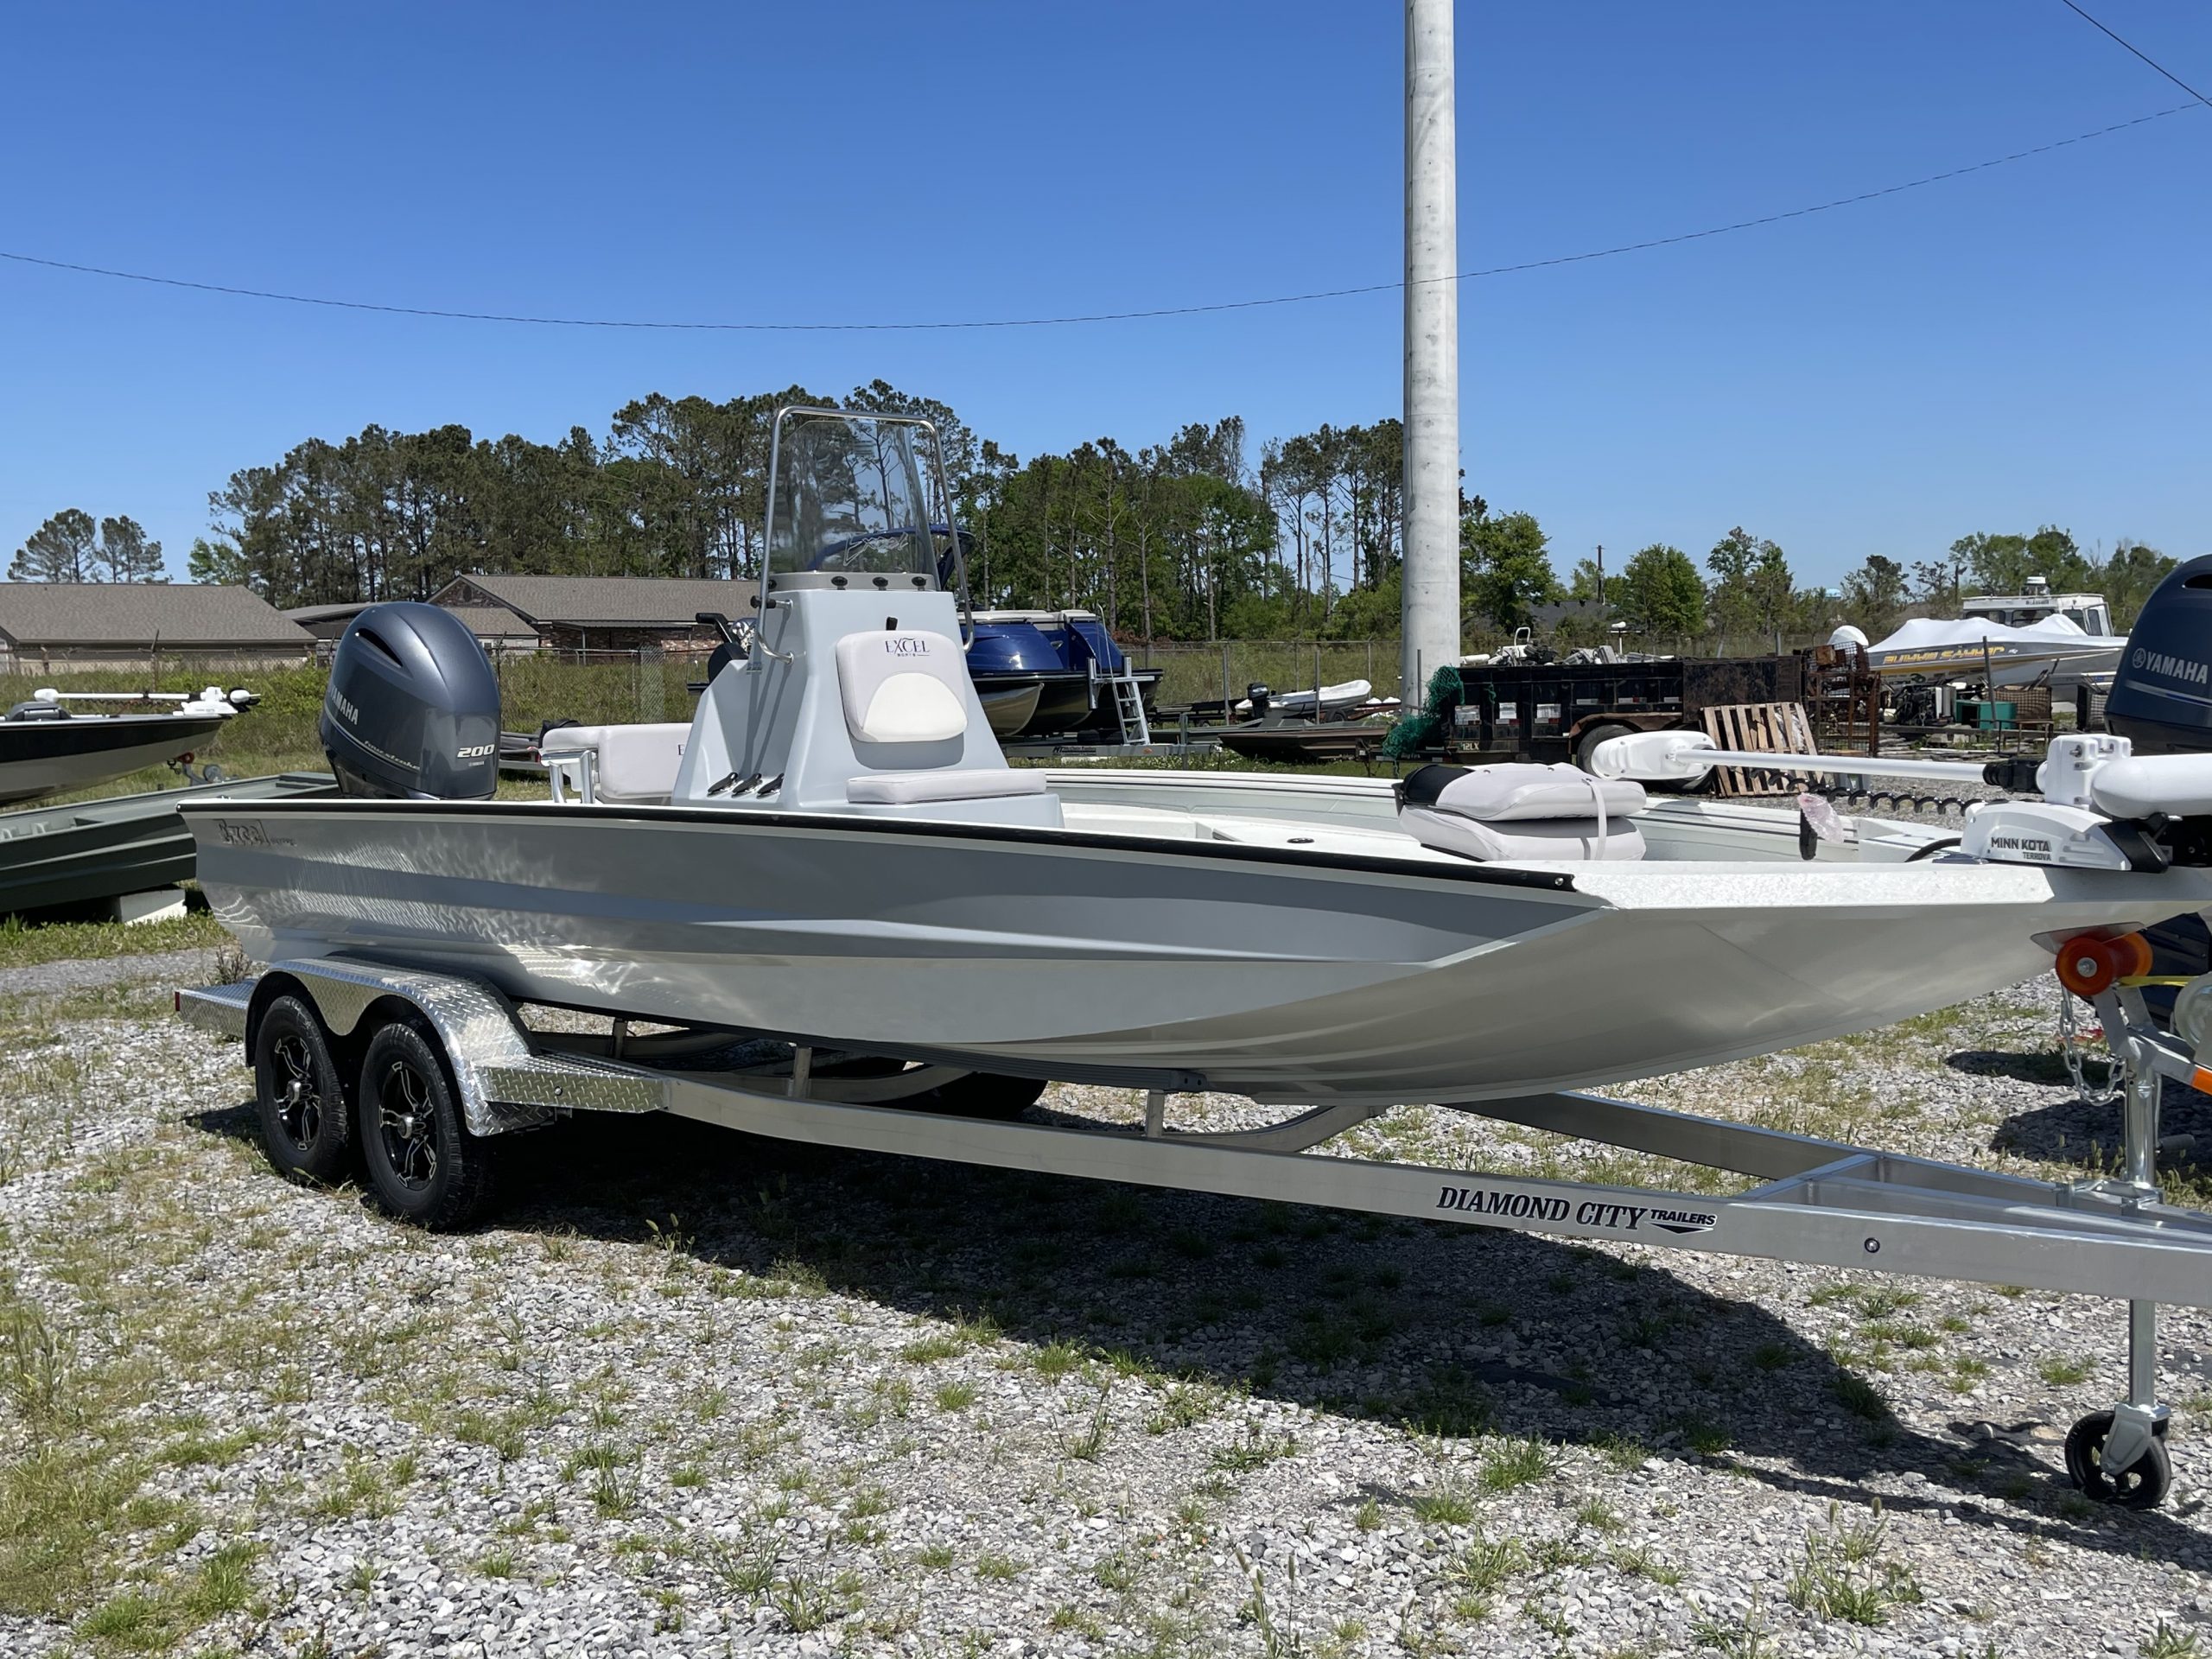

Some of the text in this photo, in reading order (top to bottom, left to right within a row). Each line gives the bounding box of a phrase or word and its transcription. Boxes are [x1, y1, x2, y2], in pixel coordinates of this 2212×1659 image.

[885, 638, 931, 654] EXCEL
[2146, 652, 2209, 684] YAMAHA
[457, 744, 494, 758] 200
[1991, 837, 2051, 852] MINN KOTA
[1436, 1186, 1716, 1230] DIAMOND CITY TRAILERS
